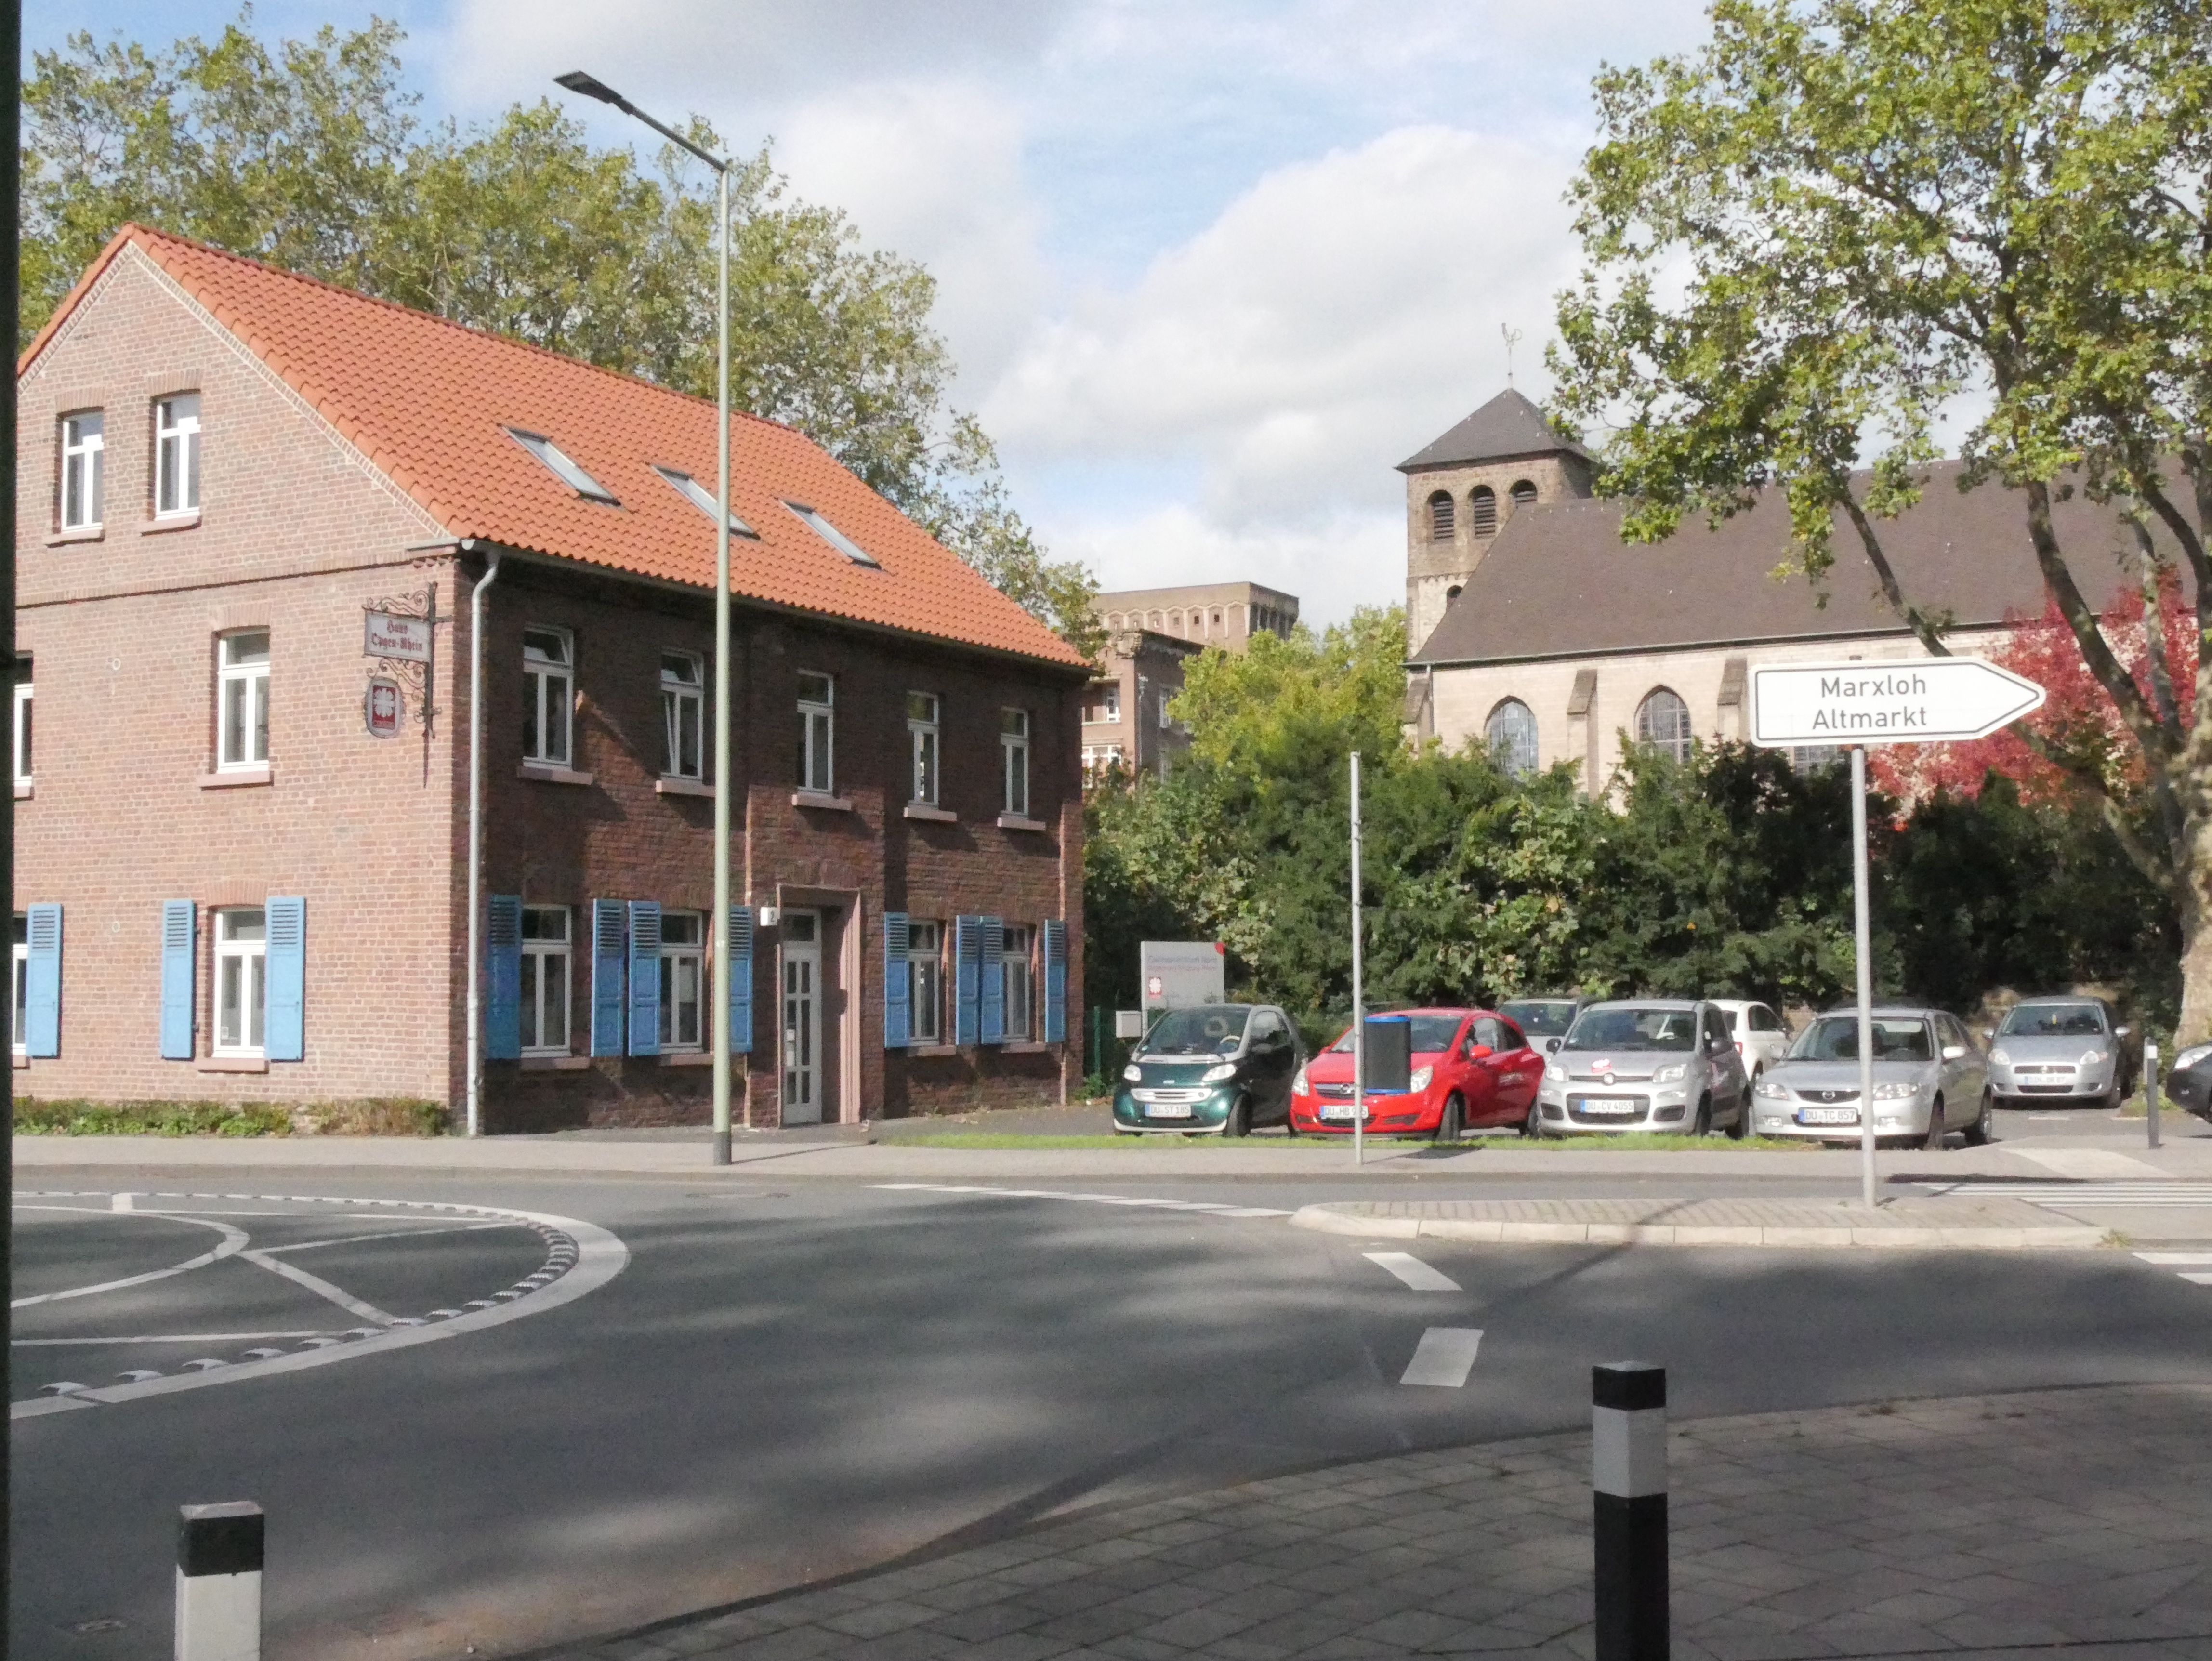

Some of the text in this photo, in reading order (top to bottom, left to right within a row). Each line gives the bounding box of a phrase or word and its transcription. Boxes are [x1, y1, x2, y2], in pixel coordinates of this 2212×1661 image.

[1821, 674, 1926, 698] Marxloh
[1812, 706, 1927, 730] Altmarkt
[1587, 1101, 1633, 1110] DU CV 4055
[1325, 1107, 1334, 1116] DU
[1340, 1107, 1349, 1116] HB
[1805, 1111, 1855, 1120] DU TC 857
